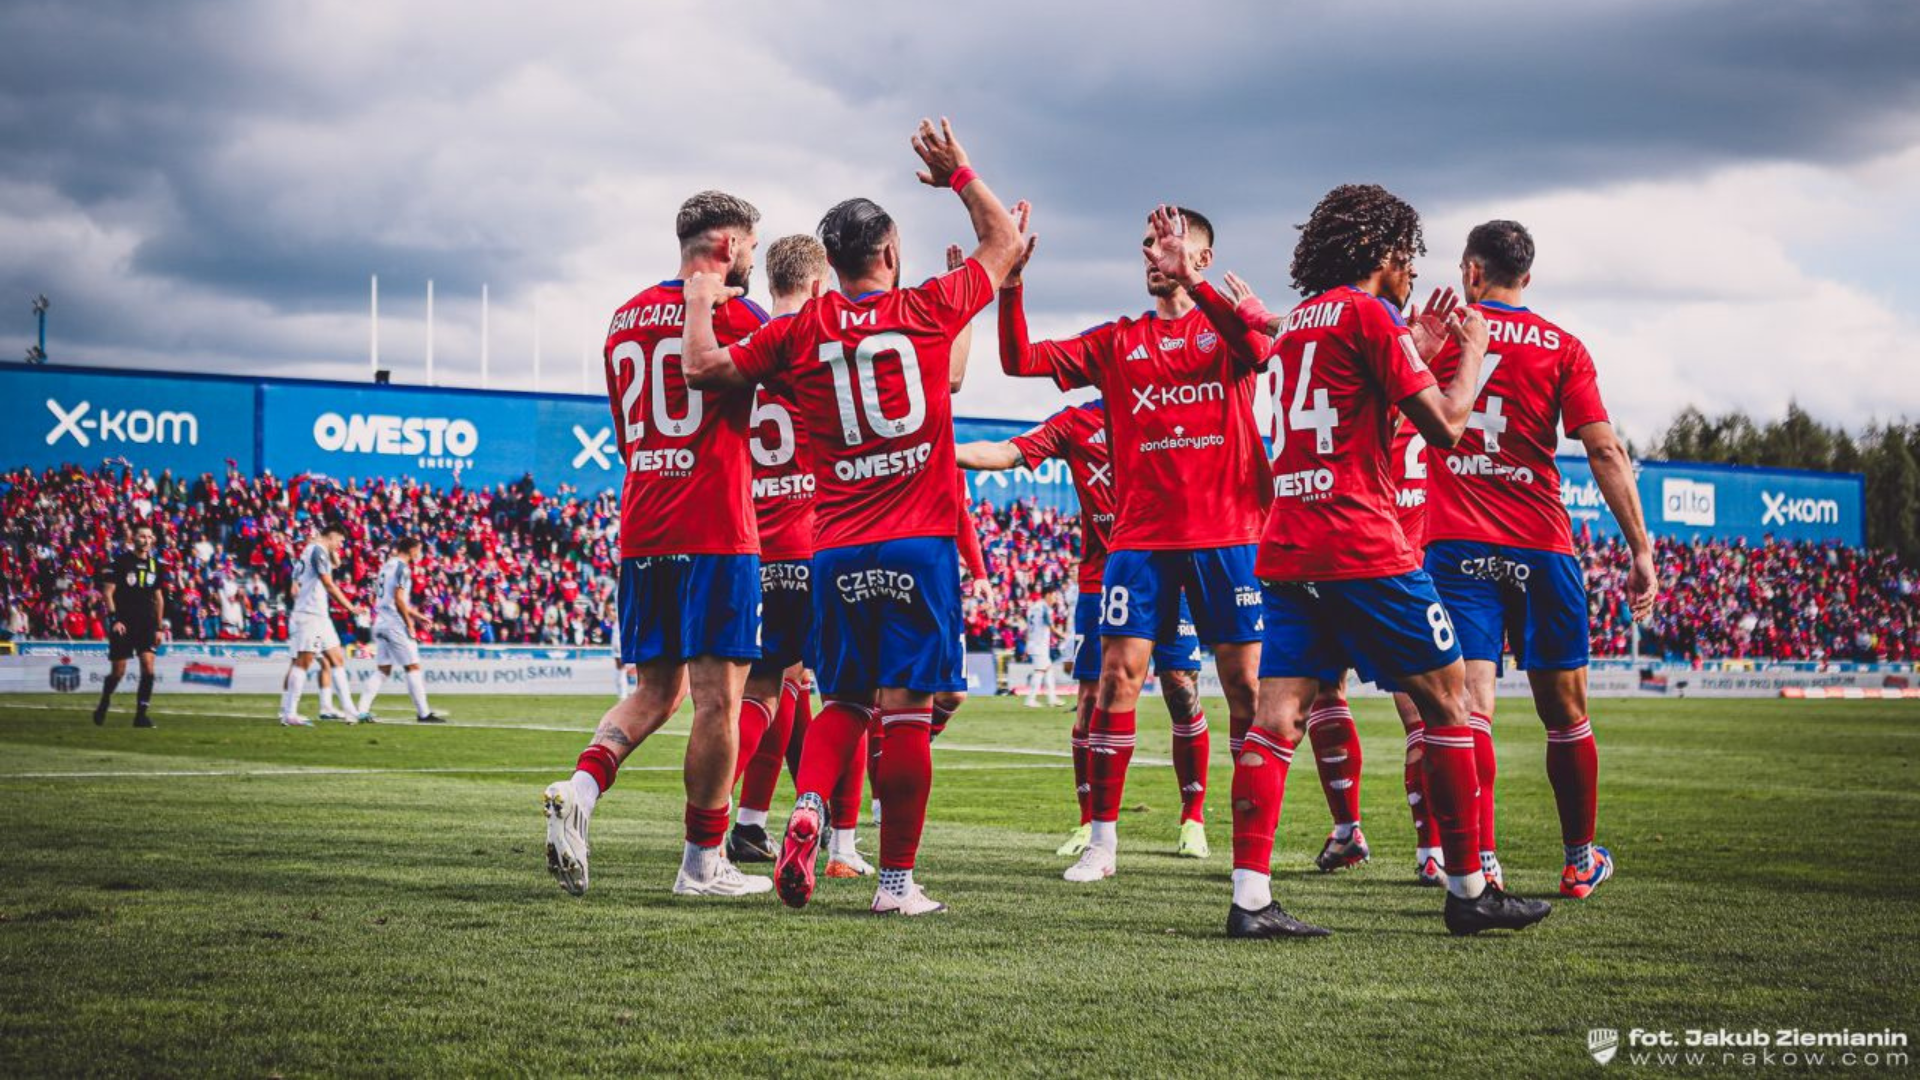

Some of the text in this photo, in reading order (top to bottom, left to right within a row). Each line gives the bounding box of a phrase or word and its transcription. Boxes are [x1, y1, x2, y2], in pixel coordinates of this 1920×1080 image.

[638, 303, 684, 327] CARL
[1487, 319, 1560, 350] RNAS
[612, 337, 702, 443] 20
[819, 332, 926, 446] 10
[313, 412, 478, 457] ONESTO
[1140, 433, 1224, 453] zondacrypto
[834, 442, 932, 481] ONESTO
[752, 473, 816, 498] NESTO
[1426, 602, 1455, 651] 8
